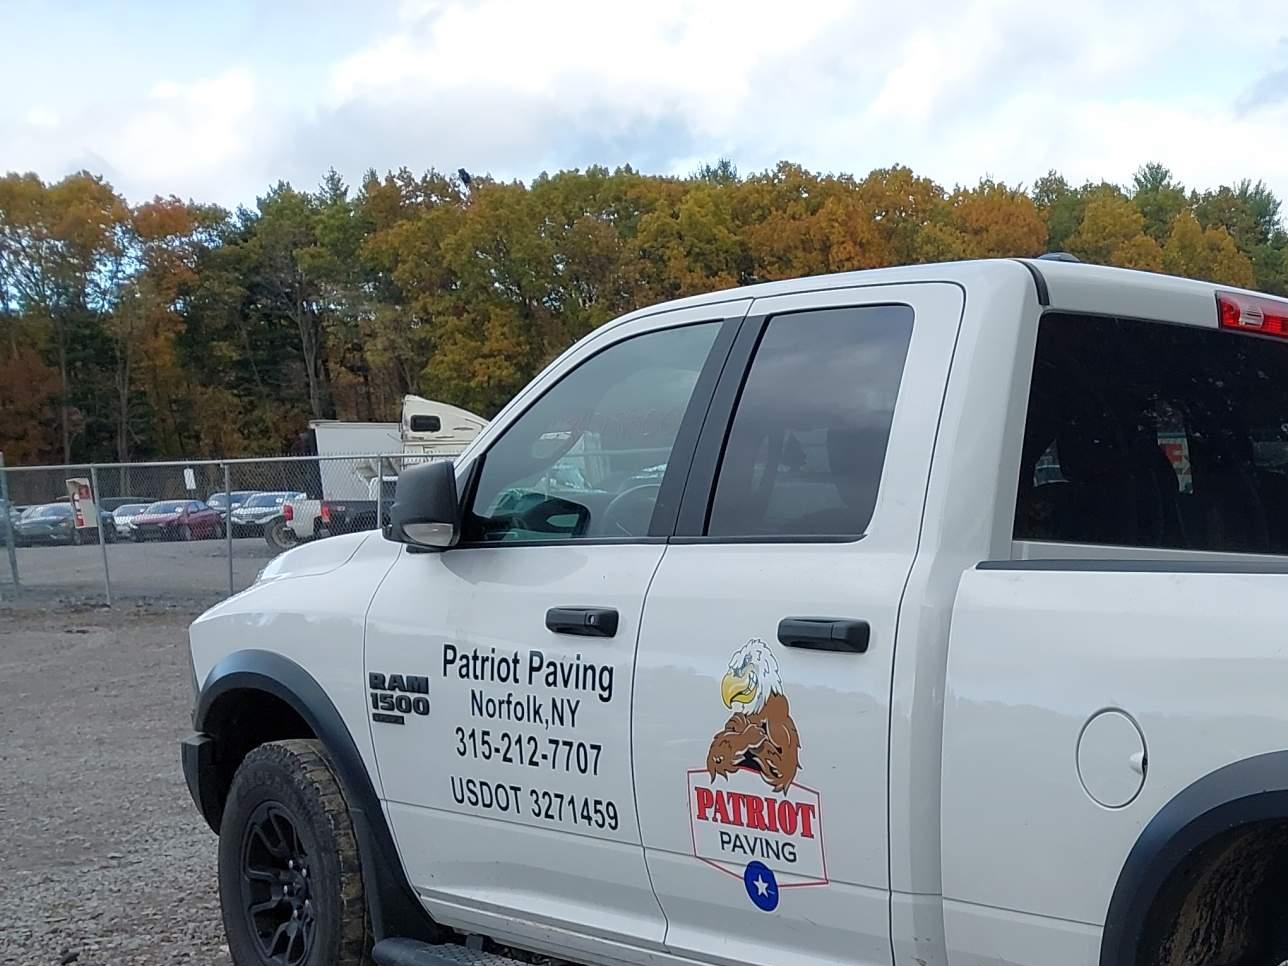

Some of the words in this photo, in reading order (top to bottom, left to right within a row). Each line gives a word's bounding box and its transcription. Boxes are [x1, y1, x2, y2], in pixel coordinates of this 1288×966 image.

[368, 671, 430, 695] RAM
[442, 643, 520, 684] Patriot
[528, 650, 615, 703] Paving
[370, 692, 431, 716] 1500
[470, 688, 581, 731] Norfolk,NY
[455, 726, 603, 777] 315-212-7707
[450, 775, 522, 815] USDOT
[529, 788, 619, 831] 3271459
[694, 786, 817, 840] PATRIOT
[718, 830, 798, 864] PAVING
